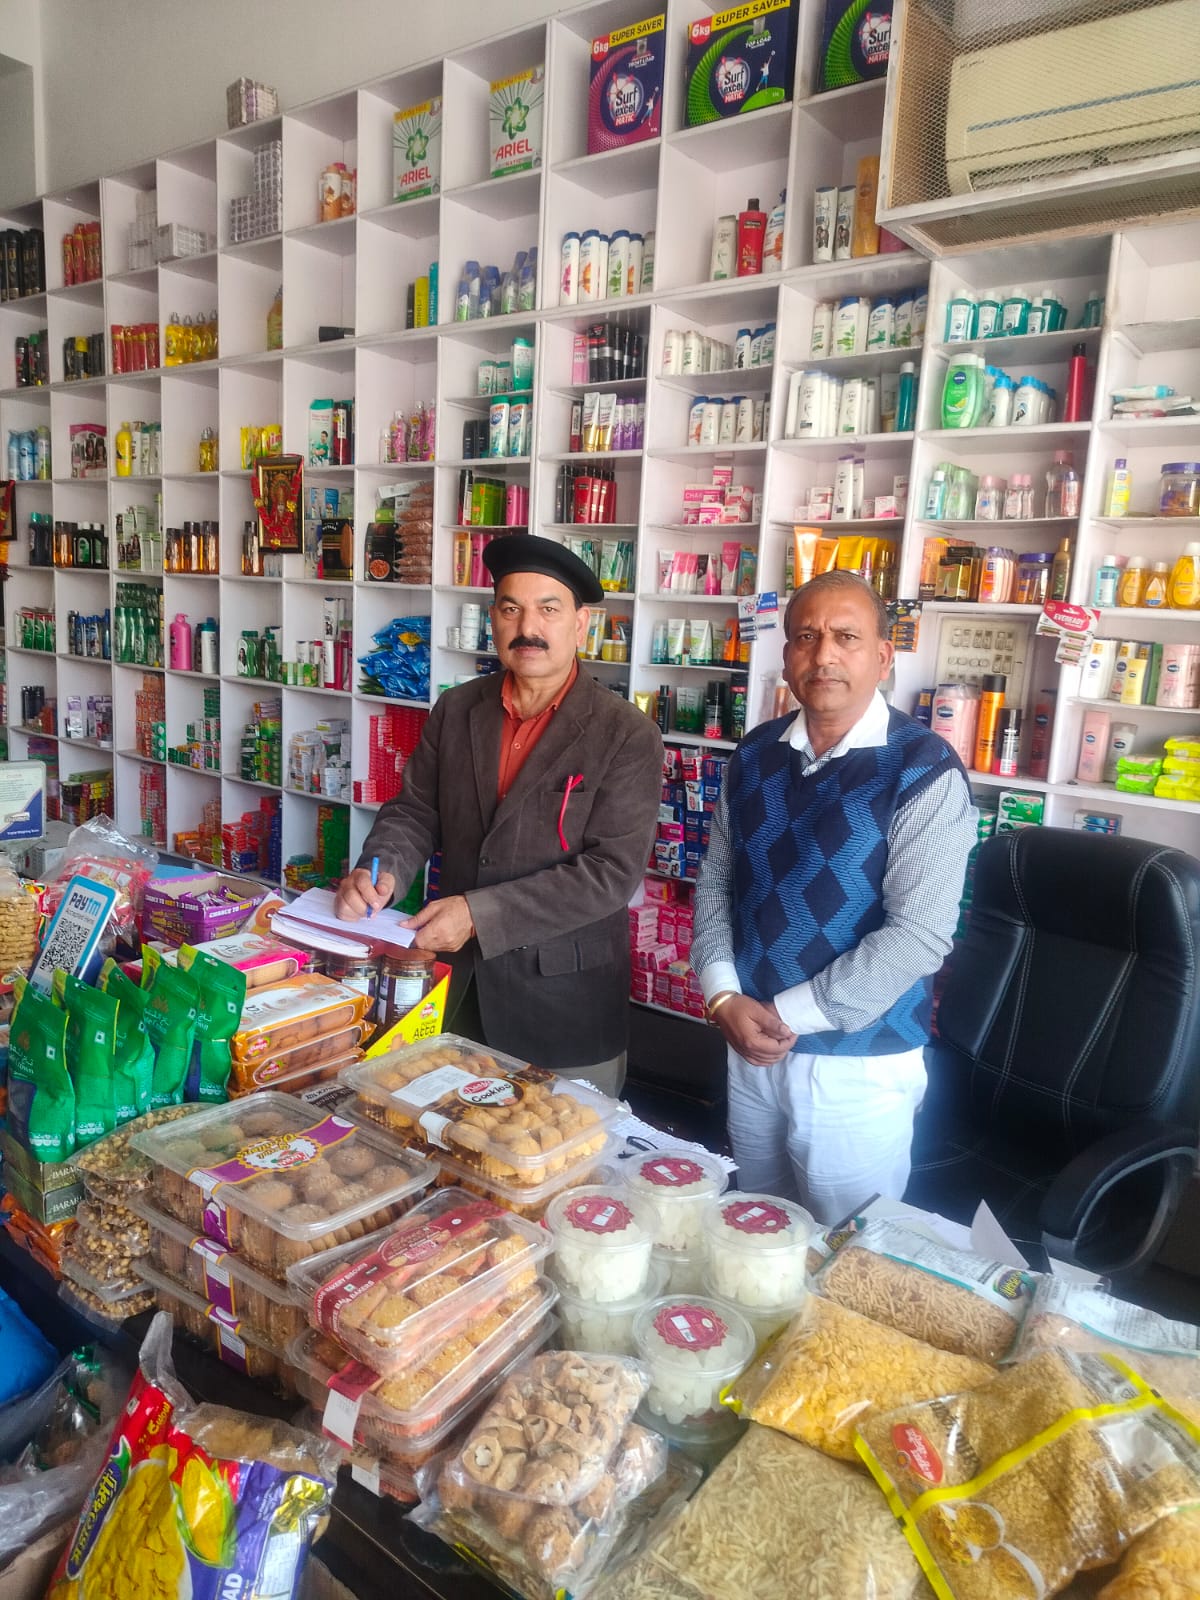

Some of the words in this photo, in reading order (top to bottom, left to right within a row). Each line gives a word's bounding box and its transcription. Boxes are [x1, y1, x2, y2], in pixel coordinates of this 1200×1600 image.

[715, 8, 749, 26] SUPER
[752, 0, 786, 14] SAVER
[611, 28, 635, 43] SUPER
[637, 19, 662, 34] SAVER
[692, 24, 711, 37] 6kg
[593, 41, 609, 54] 6kg
[724, 69, 745, 86] Surf
[616, 87, 638, 106] Surf
[723, 82, 743, 94] excel
[615, 103, 636, 117] excel
[495, 138, 533, 162] ARIEL
[400, 166, 432, 187] ARIEL
[414, 1026, 436, 1037] Atta
[472, 1083, 512, 1103] Cookies
